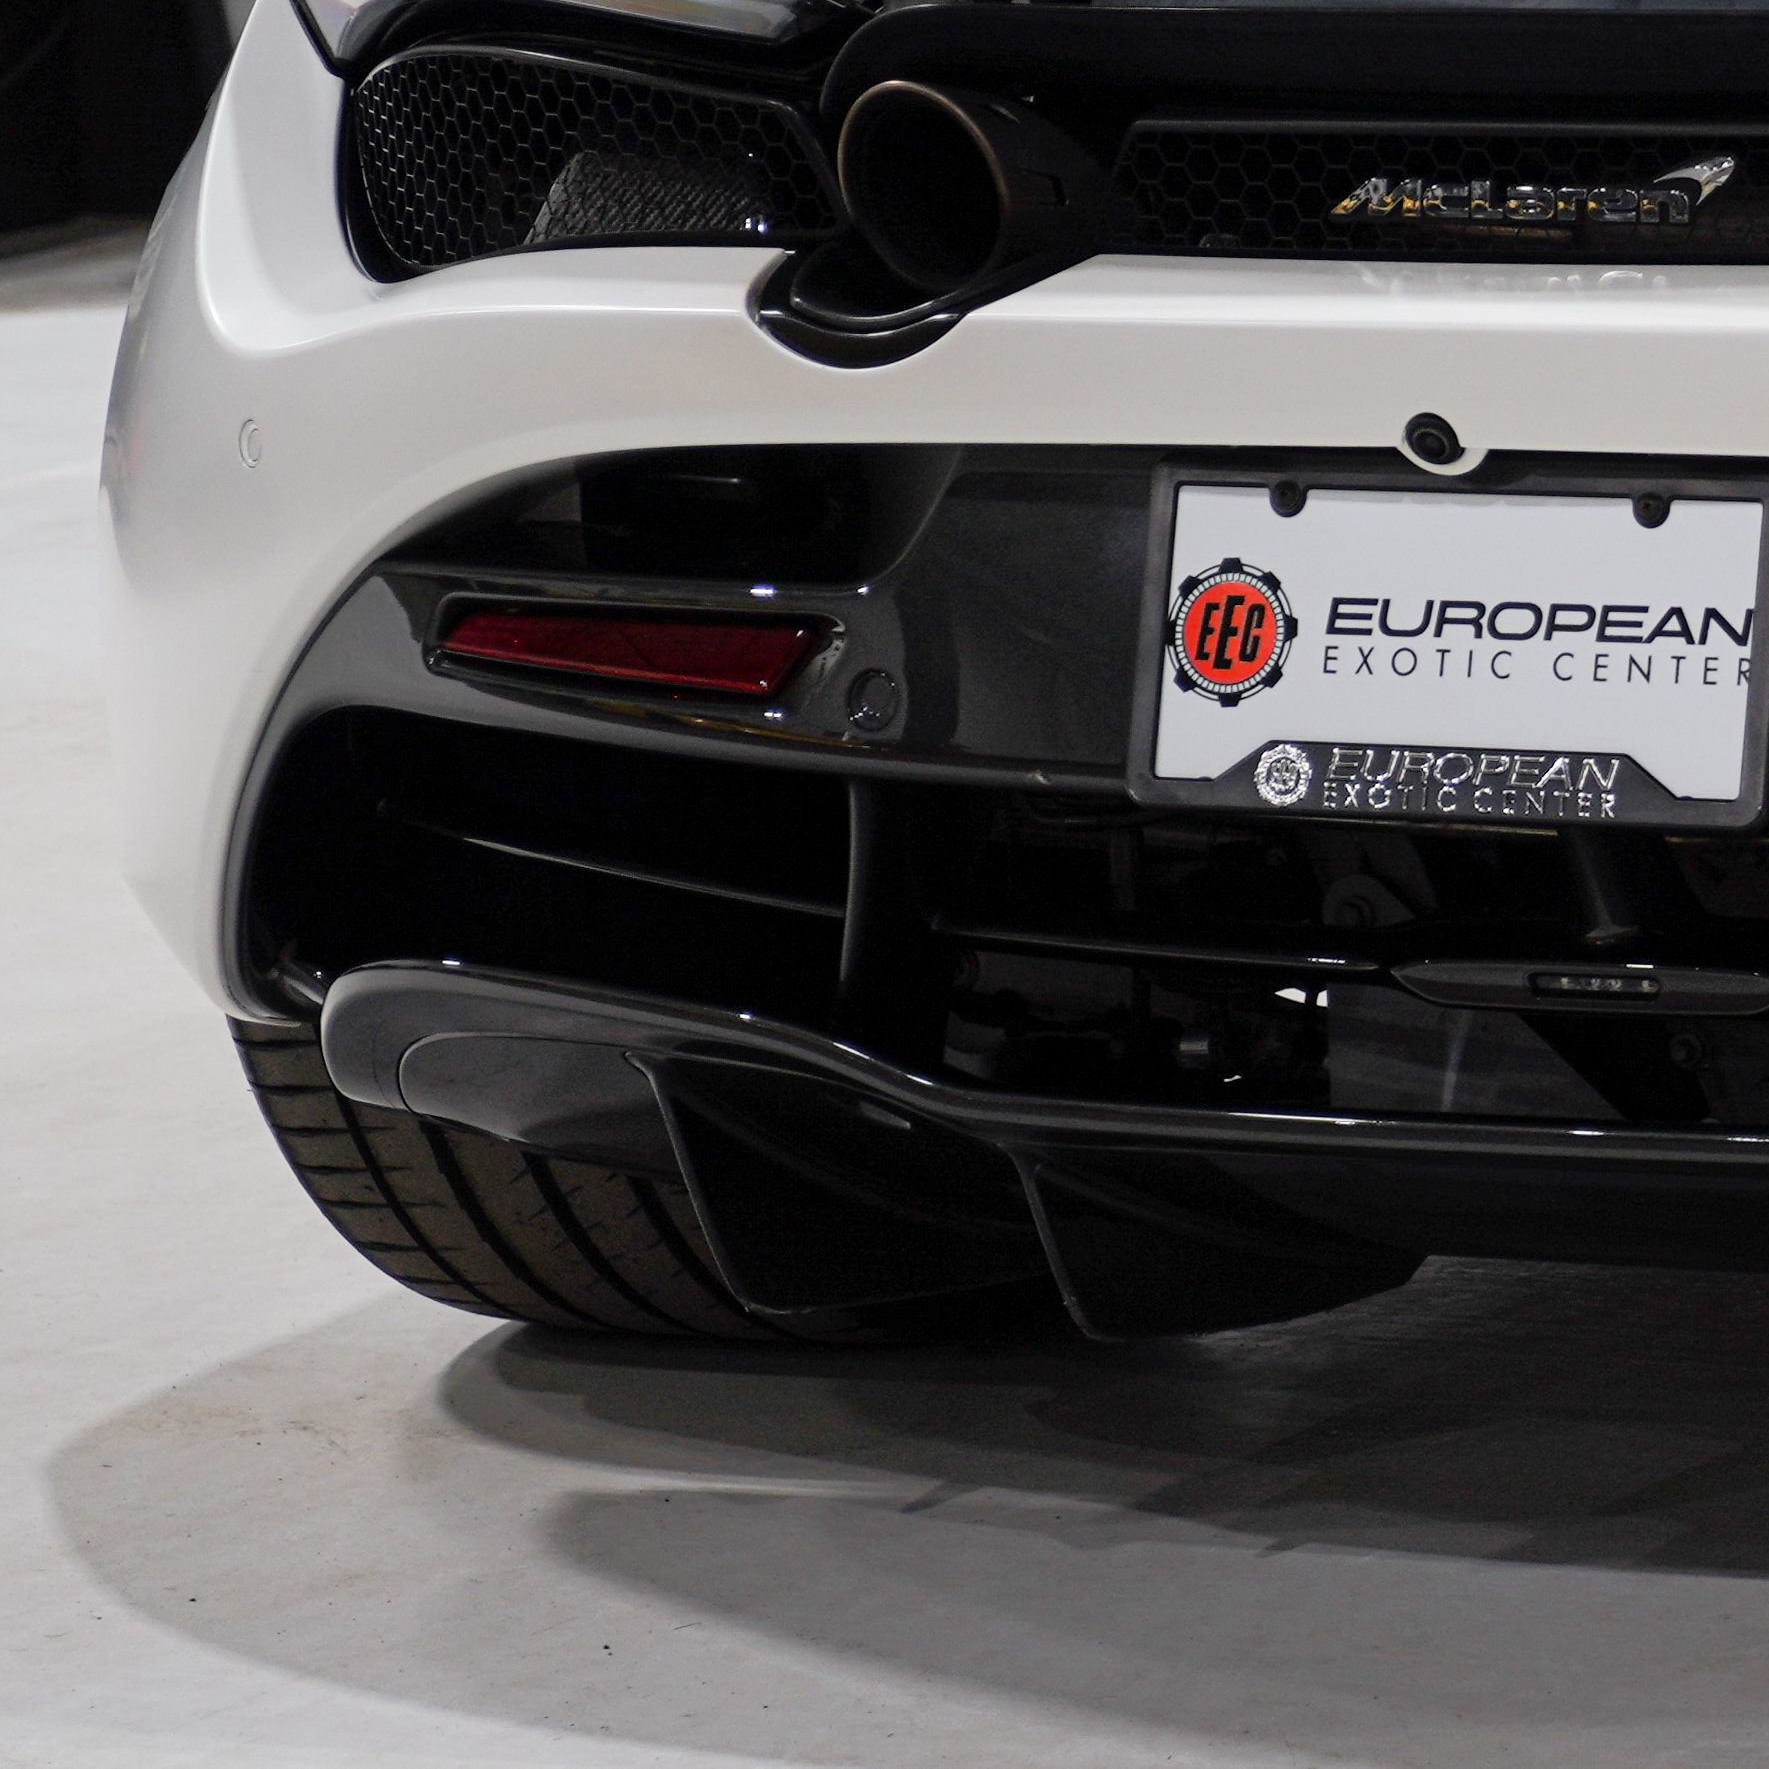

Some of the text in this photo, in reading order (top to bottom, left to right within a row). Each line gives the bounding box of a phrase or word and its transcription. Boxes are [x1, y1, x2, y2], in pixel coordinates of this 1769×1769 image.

[1332, 176, 1690, 224] McLaren
[1195, 595, 1266, 670] EEC
[1325, 597, 1755, 647] EUROPEAN
[1323, 645, 1751, 686] EXOTIC CENTER
[1327, 746, 1620, 791] EUROPEAN
[1323, 781, 1616, 819] EXOTIC CENTER
